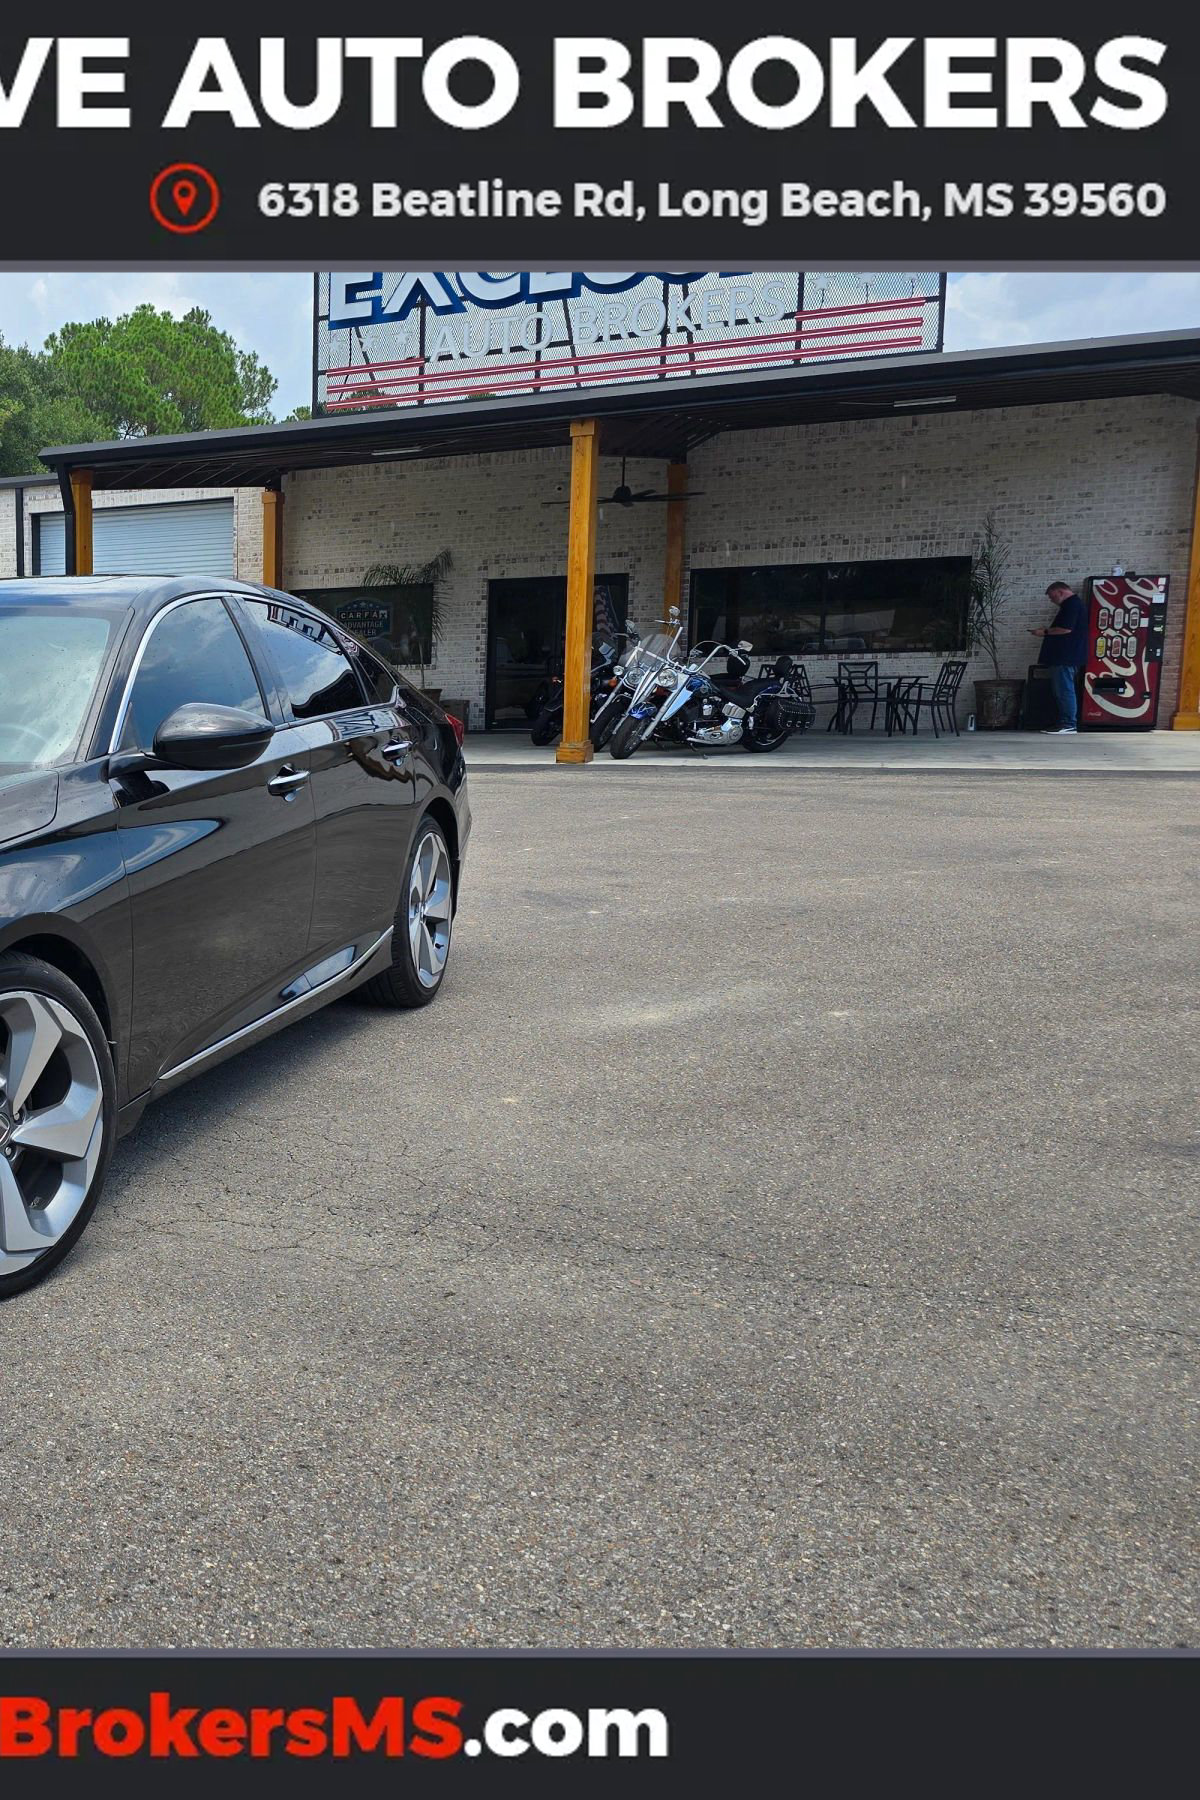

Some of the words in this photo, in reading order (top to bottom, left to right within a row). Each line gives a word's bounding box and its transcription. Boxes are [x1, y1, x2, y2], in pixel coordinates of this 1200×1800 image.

[429, 312, 553, 363] AUTO
[573, 280, 786, 346] BROKERS
[340, 610, 388, 619] CARFAX
